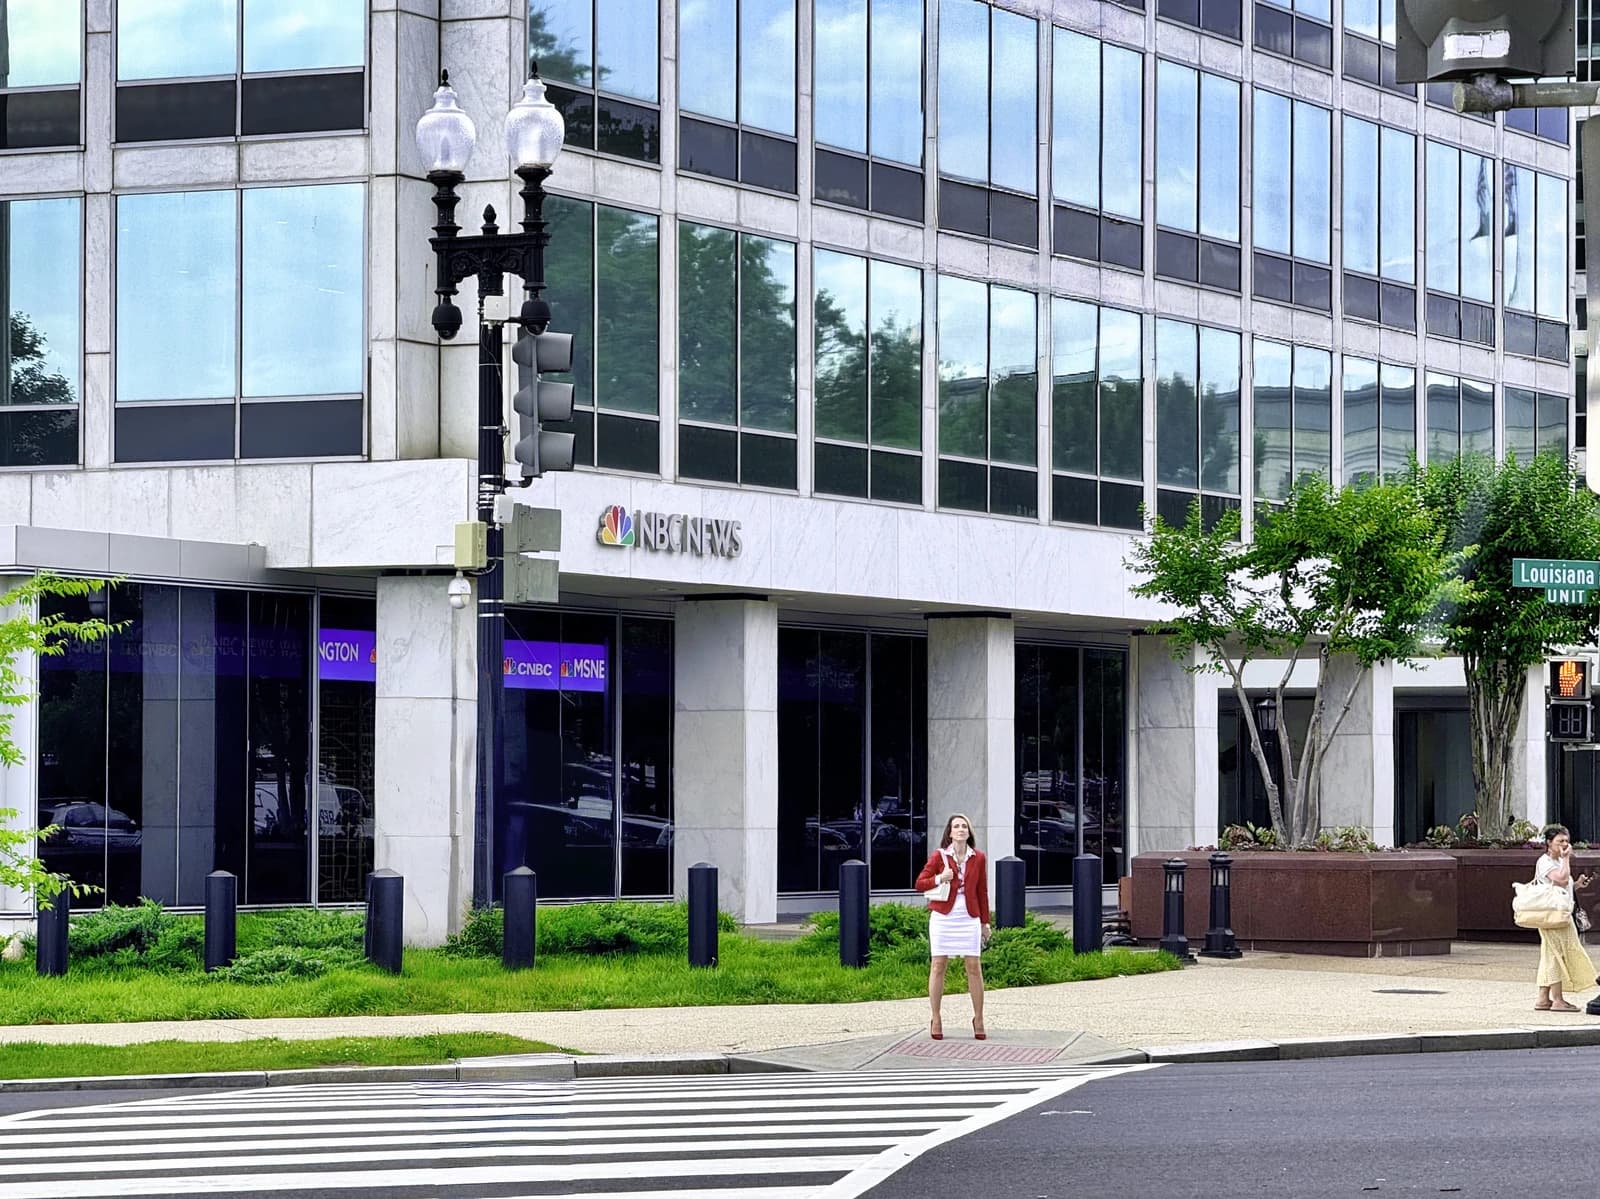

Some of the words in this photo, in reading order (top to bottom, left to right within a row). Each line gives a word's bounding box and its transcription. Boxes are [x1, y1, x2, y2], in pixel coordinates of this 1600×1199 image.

[635, 510, 682, 552] NBC
[683, 515, 742, 558] NEWS
[1521, 562, 1594, 585] Louisiana
[1547, 589, 1585, 604] UNIT
[518, 662, 552, 676] CNBC
